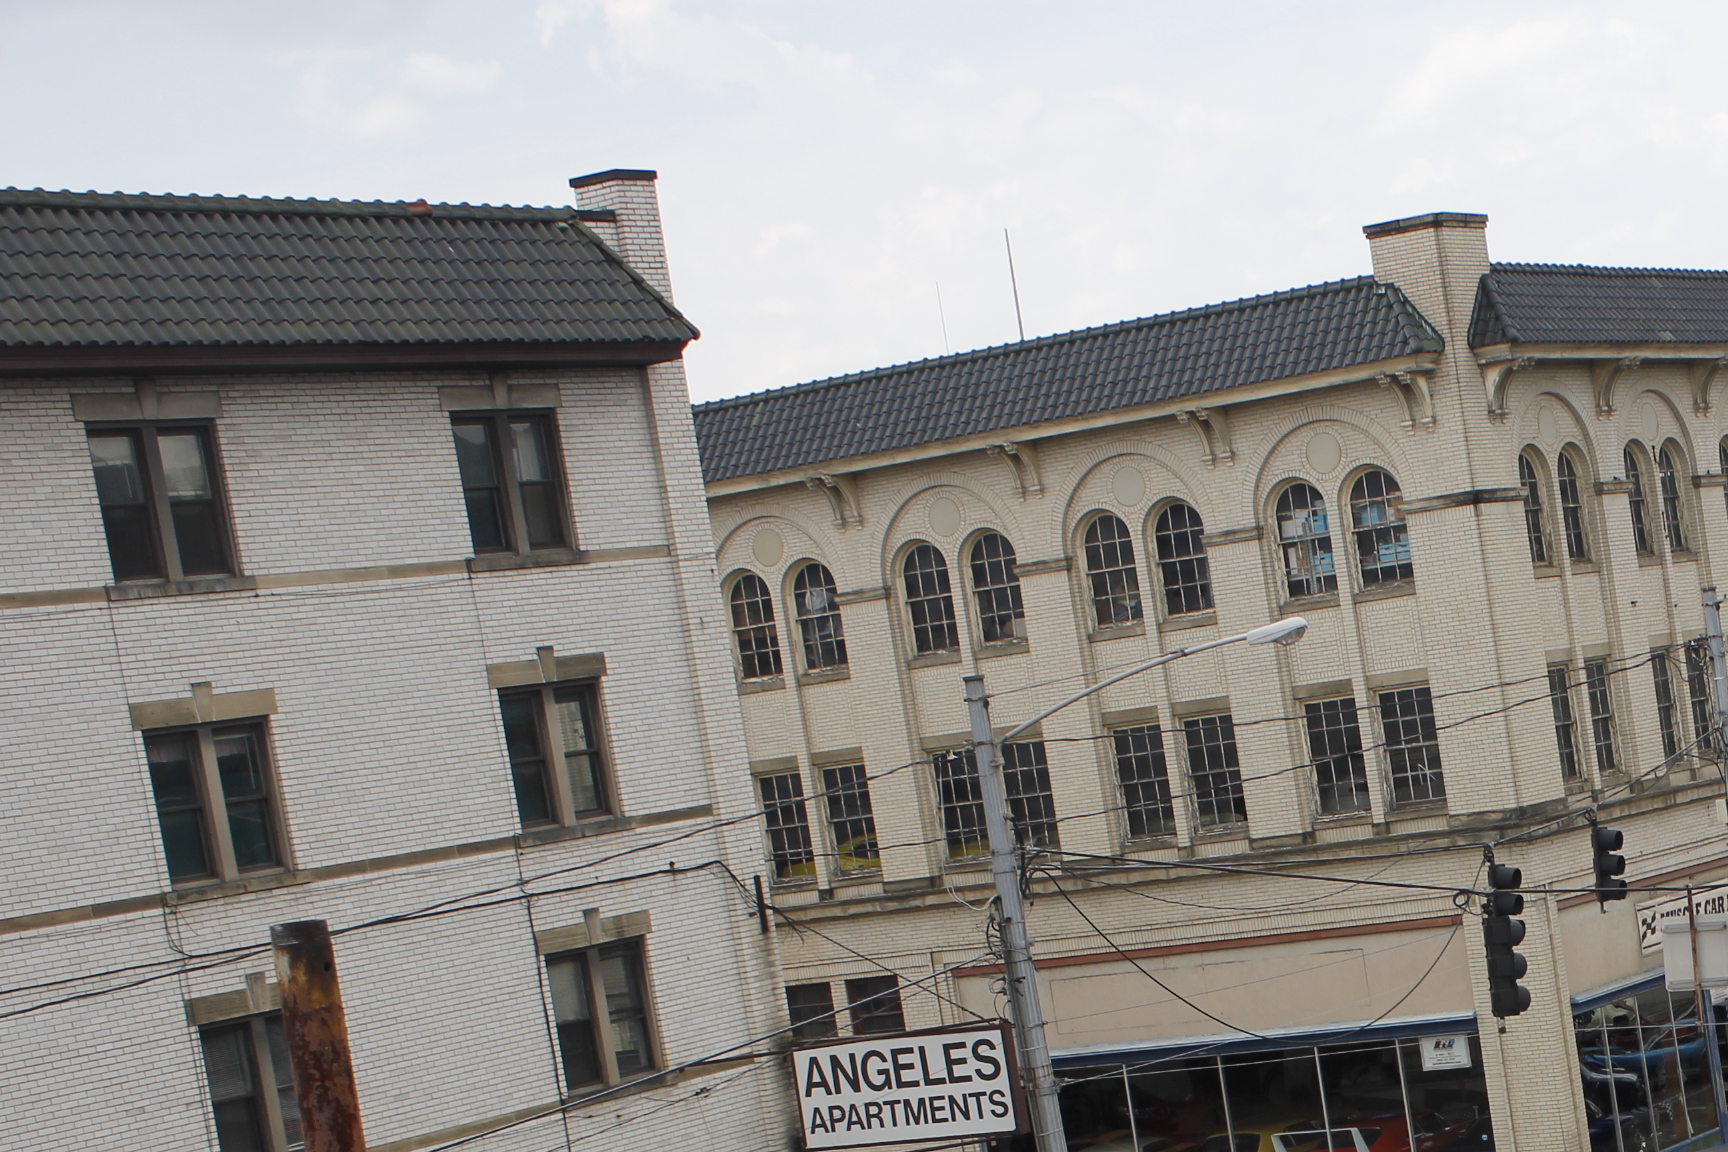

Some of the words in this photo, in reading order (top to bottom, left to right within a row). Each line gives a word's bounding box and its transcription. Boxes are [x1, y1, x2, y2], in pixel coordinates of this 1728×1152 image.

[1704, 896, 1724, 914] CAR
[805, 1038, 1002, 1098] ANGELES
[810, 1090, 1009, 1135] APARTMENTS
